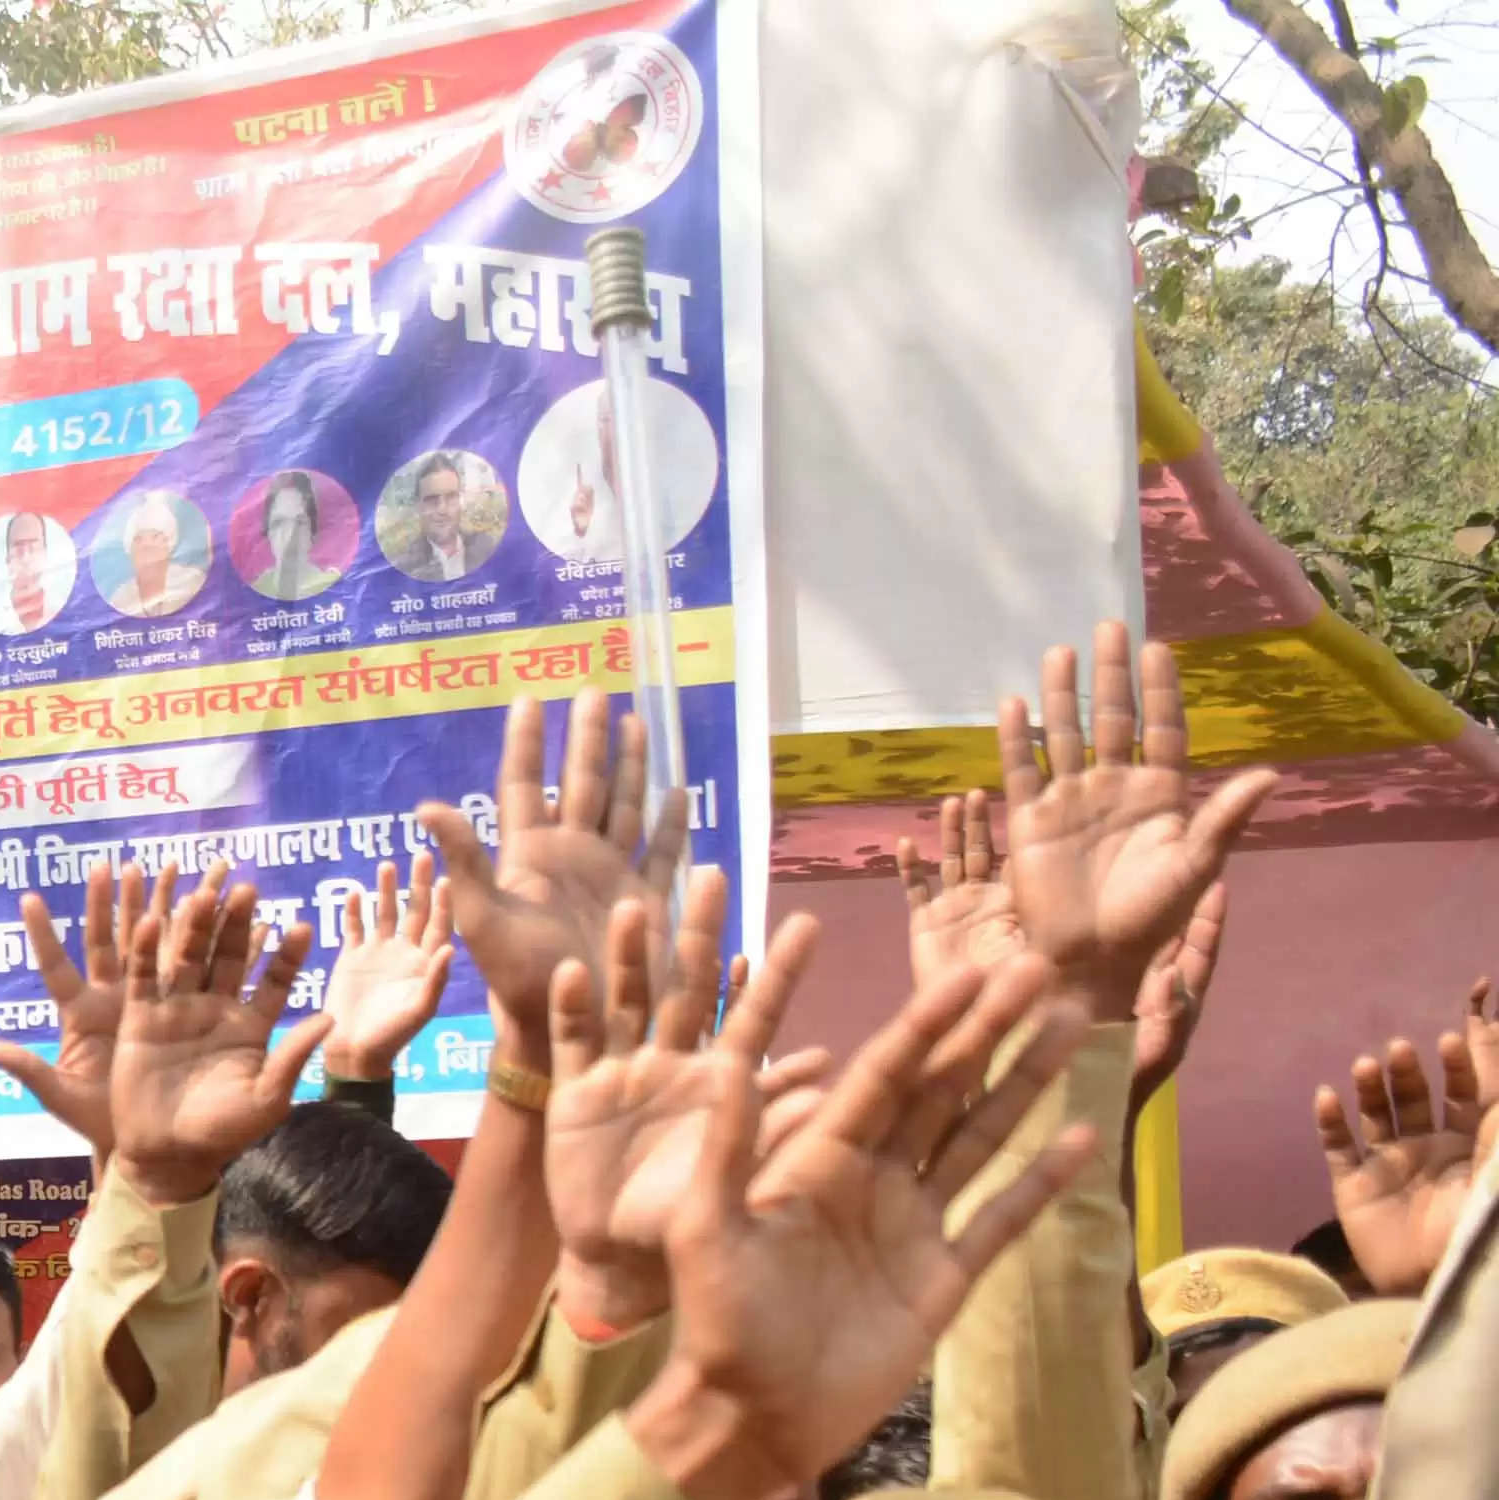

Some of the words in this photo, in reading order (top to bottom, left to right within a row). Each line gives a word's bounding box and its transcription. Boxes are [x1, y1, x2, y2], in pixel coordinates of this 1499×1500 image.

[234, 103, 329, 145] पटना
[340, 79, 407, 128] चलें
[106, 243, 243, 343] रक्षा
[254, 242, 401, 356] दल,
[11, 398, 184, 458] 4152/12
[251, 609, 309, 632] संगीता
[314, 603, 344, 624] देवी
[126, 673, 304, 726] अनवरत
[316, 645, 501, 703] संघर्षरत
[511, 641, 592, 682] रहा
[35, 762, 107, 819] पूर्ति
[34, 833, 126, 887] जिला
[347, 813, 393, 857] पर
[286, 970, 325, 1010] में
